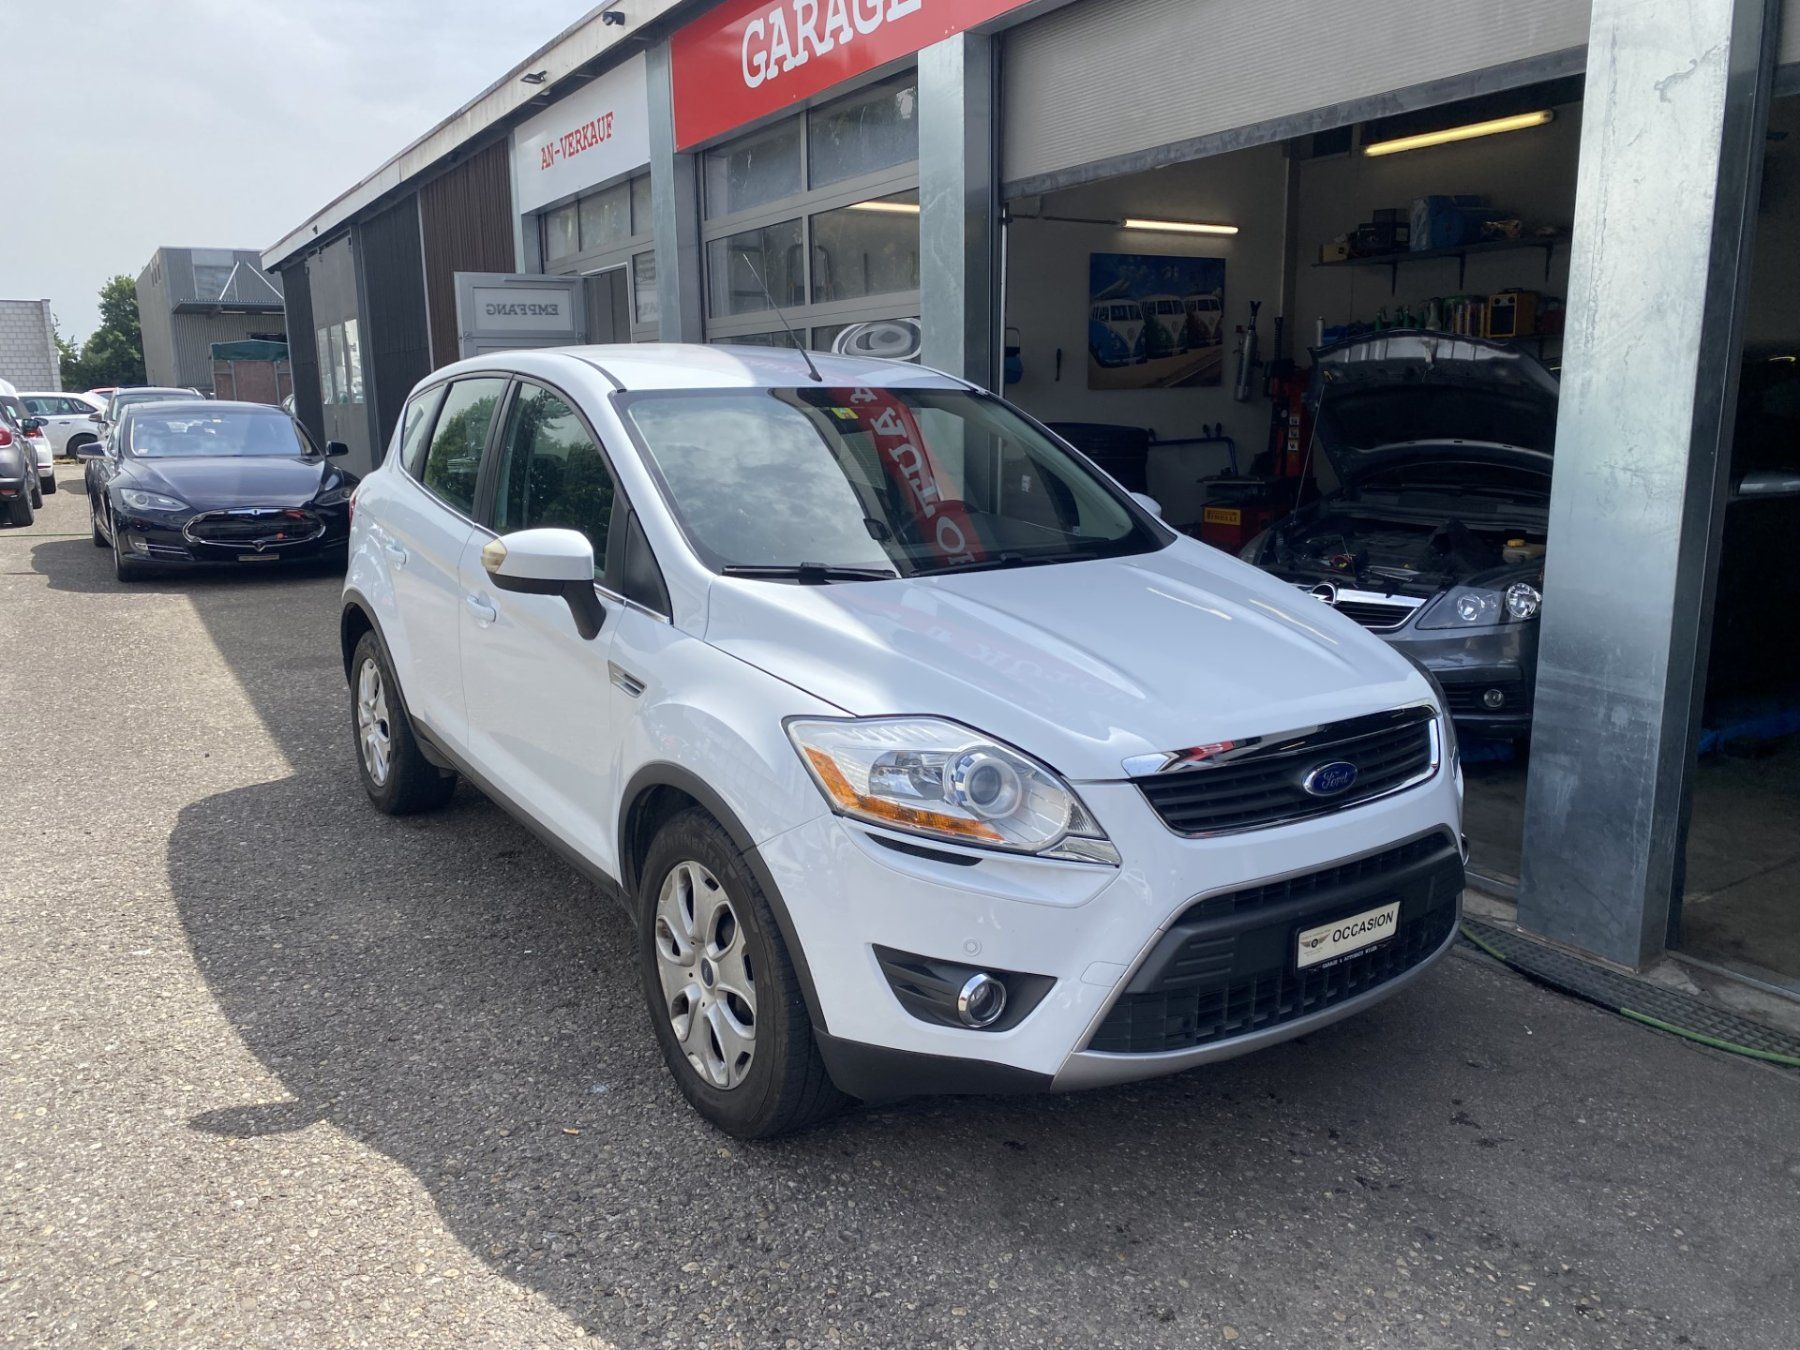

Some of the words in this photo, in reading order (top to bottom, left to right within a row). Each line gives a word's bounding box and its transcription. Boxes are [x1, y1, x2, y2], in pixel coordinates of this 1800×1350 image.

[541, 111, 613, 171] AN-VERKAUF
[1321, 770, 1348, 790] Ford
[1333, 910, 1394, 943] OCCASION
